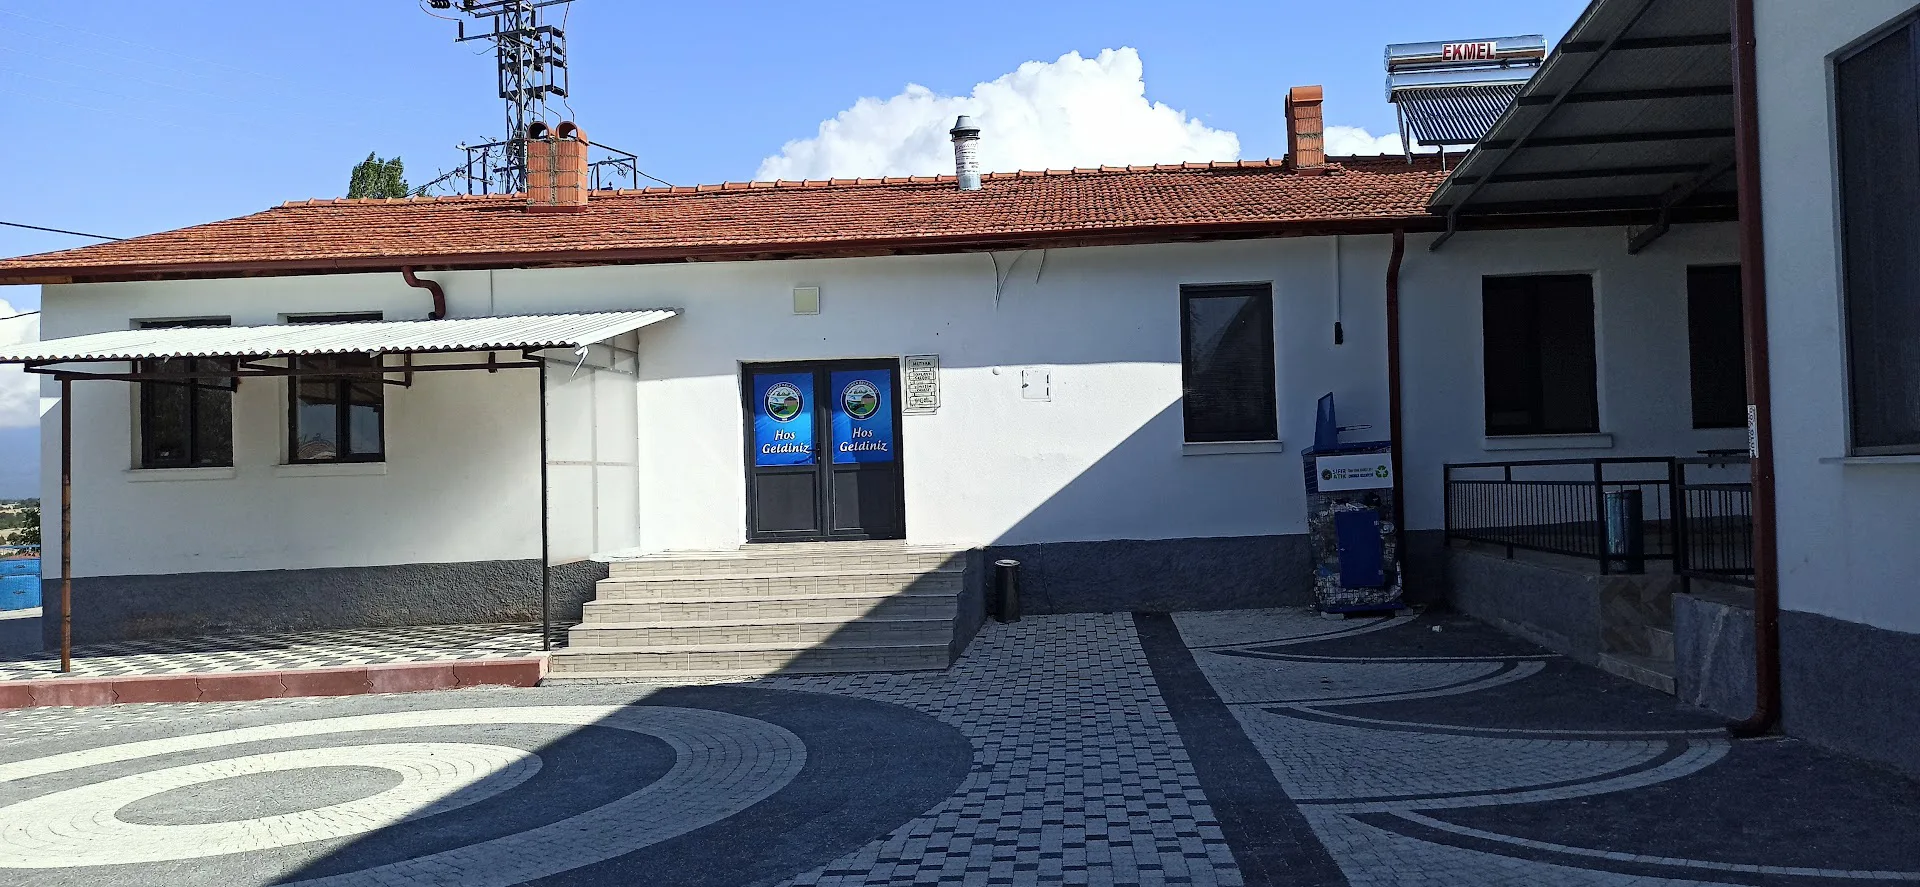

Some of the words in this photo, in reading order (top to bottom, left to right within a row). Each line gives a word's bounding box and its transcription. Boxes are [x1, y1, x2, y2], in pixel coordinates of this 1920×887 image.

[1442, 43, 1495, 60] EKMEL
[774, 429, 796, 441] Hos
[852, 427, 873, 439] Hos
[762, 443, 810, 454] Geldiniz
[839, 440, 888, 452] Geldiniz
